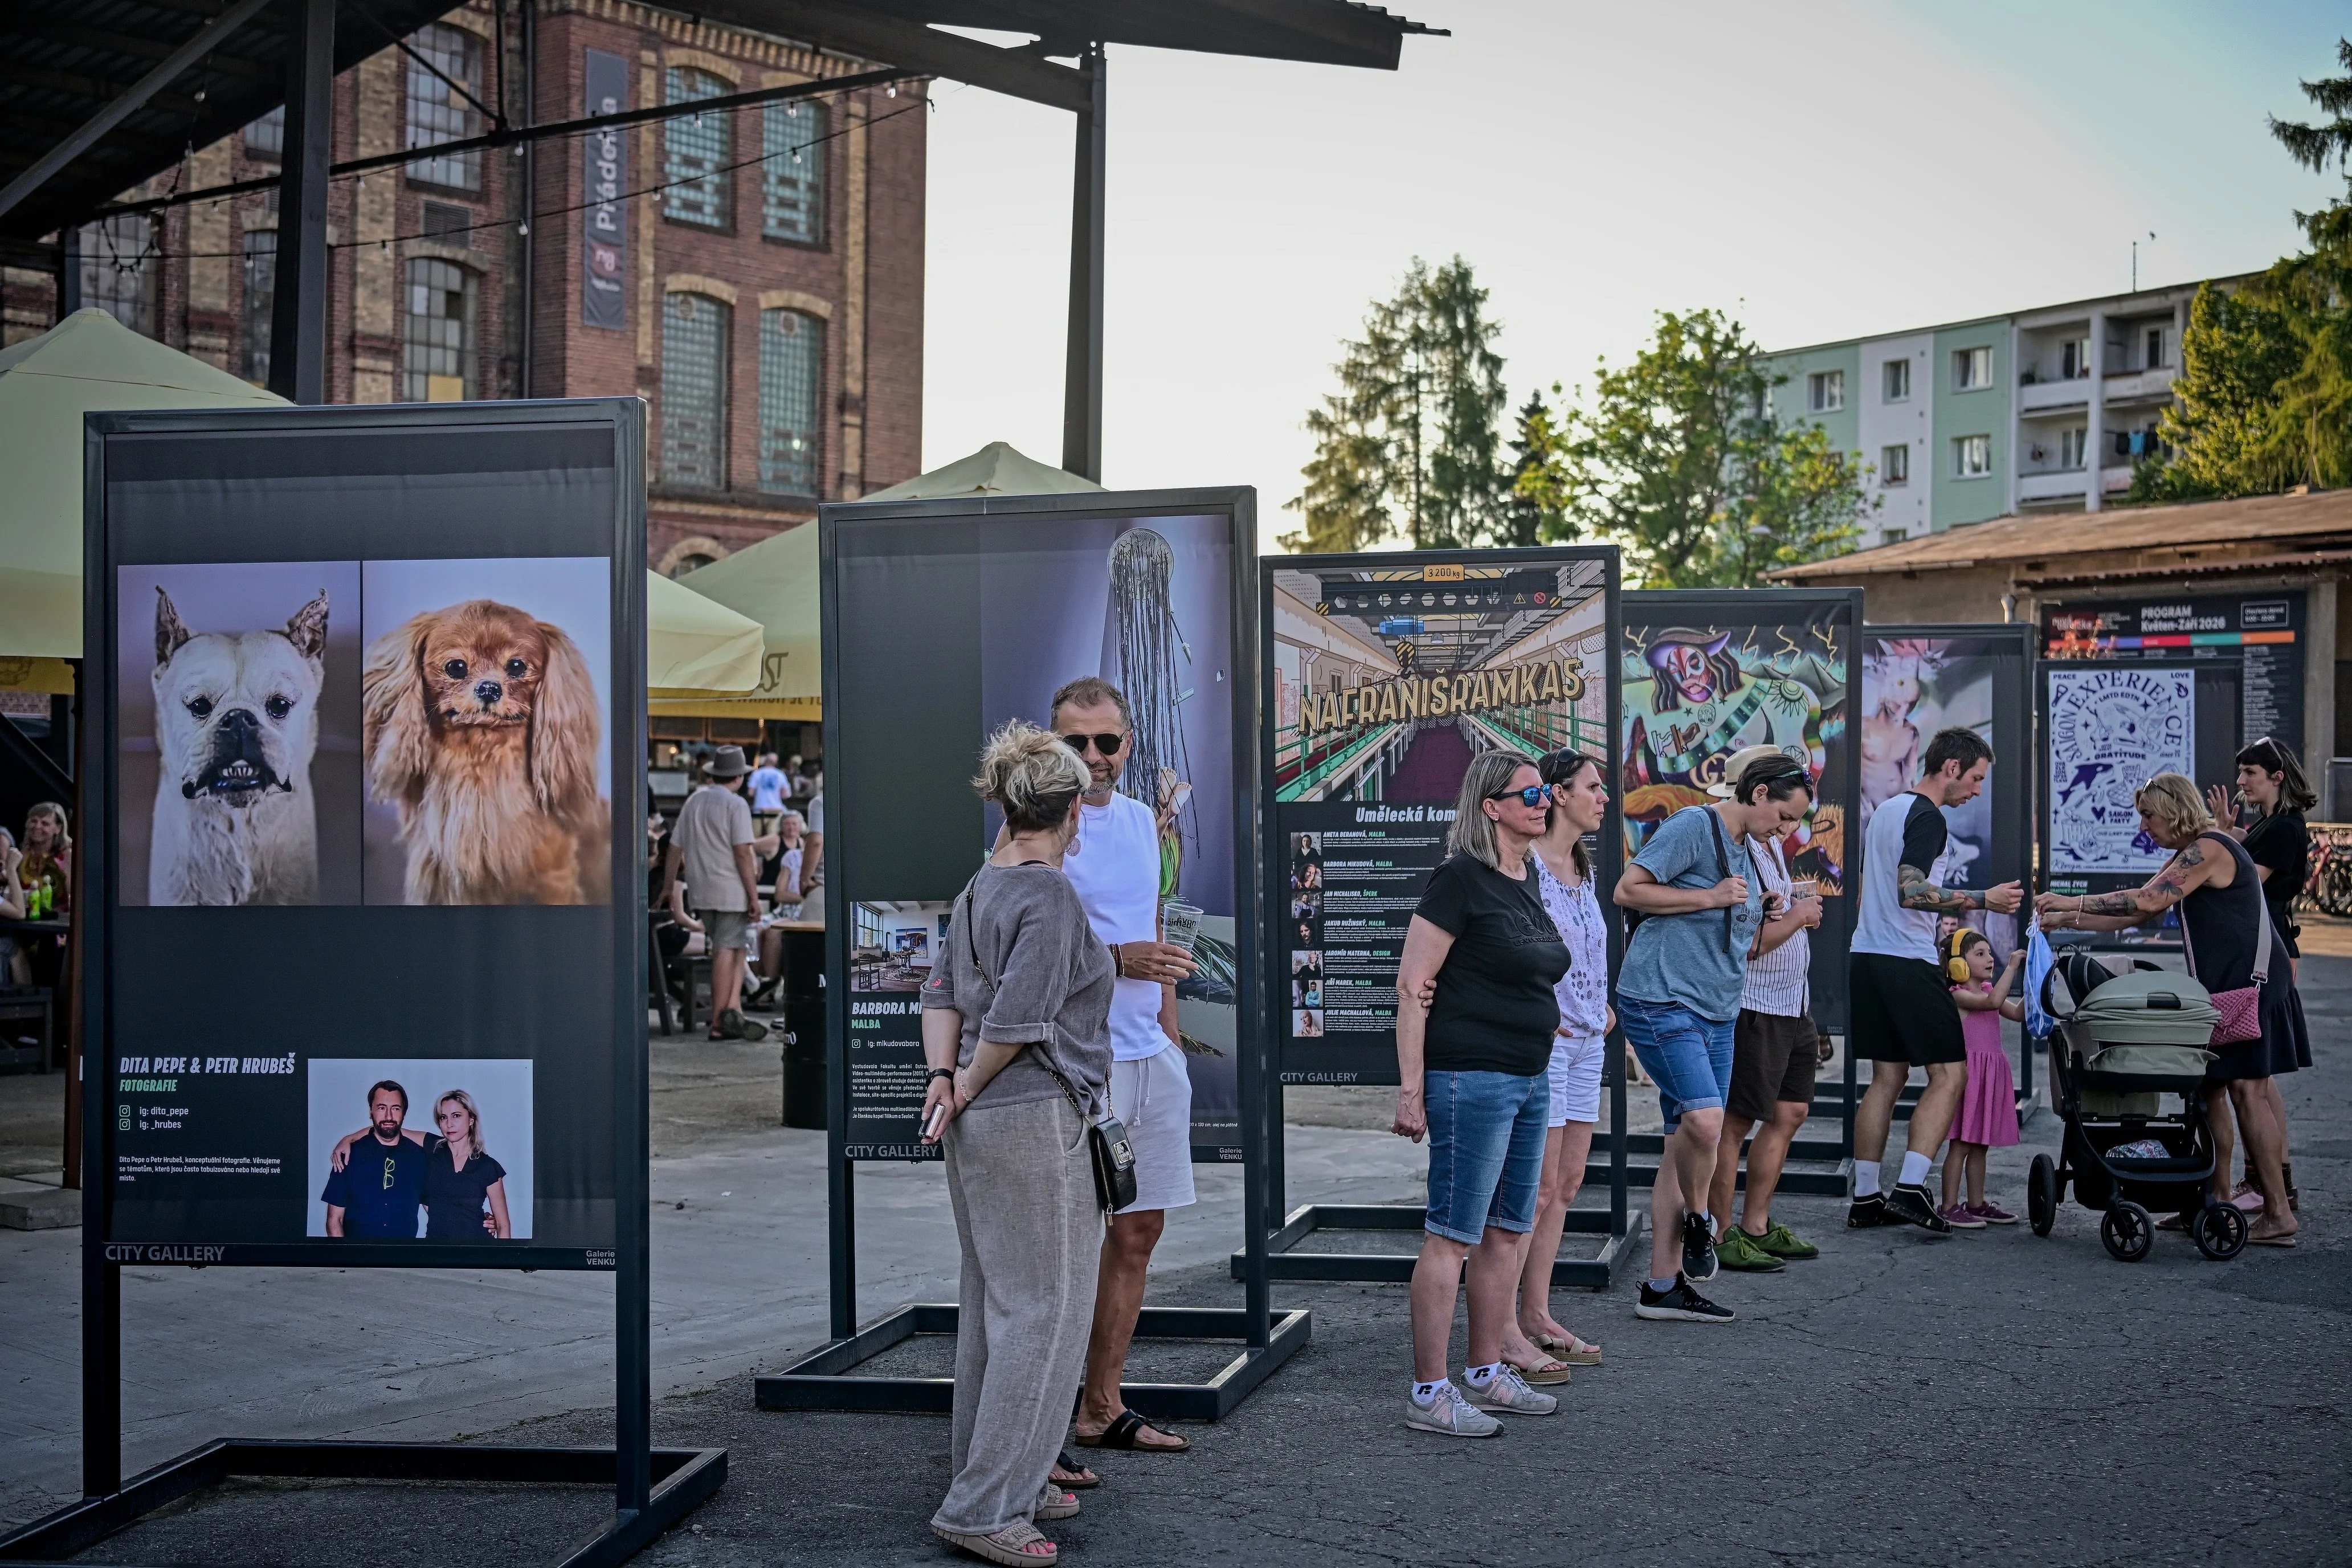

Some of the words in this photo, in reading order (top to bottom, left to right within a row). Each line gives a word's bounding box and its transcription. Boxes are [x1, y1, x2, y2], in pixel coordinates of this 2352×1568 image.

[2141, 605, 2192, 619] PROGRAM
[1355, 805, 1423, 822] Umělecká
[852, 1002, 905, 1014] BARBORA
[851, 1019, 880, 1028] MALBA
[120, 1057, 149, 1073] DITA
[153, 1057, 187, 1073] PEPE
[190, 1057, 201, 1073] &
[205, 1057, 239, 1073] PETR
[242, 1052, 296, 1074] HRUBEŠ
[1280, 1073, 1304, 1081] CITY
[1307, 1073, 1357, 1081] GALLERY
[120, 1079, 178, 1091] FOTOGRAFIE
[140, 1106, 149, 1117] ig:
[150, 1106, 189, 1116] dita_pepe
[140, 1120, 149, 1130] ig:
[150, 1120, 181, 1130] _hrubes
[845, 1146, 875, 1157] CITY
[878, 1145, 938, 1157] GALLERY
[253, 1157, 280, 1166] Věnujeme
[105, 1246, 144, 1260] CITY
[148, 1246, 225, 1261] GALLERY
